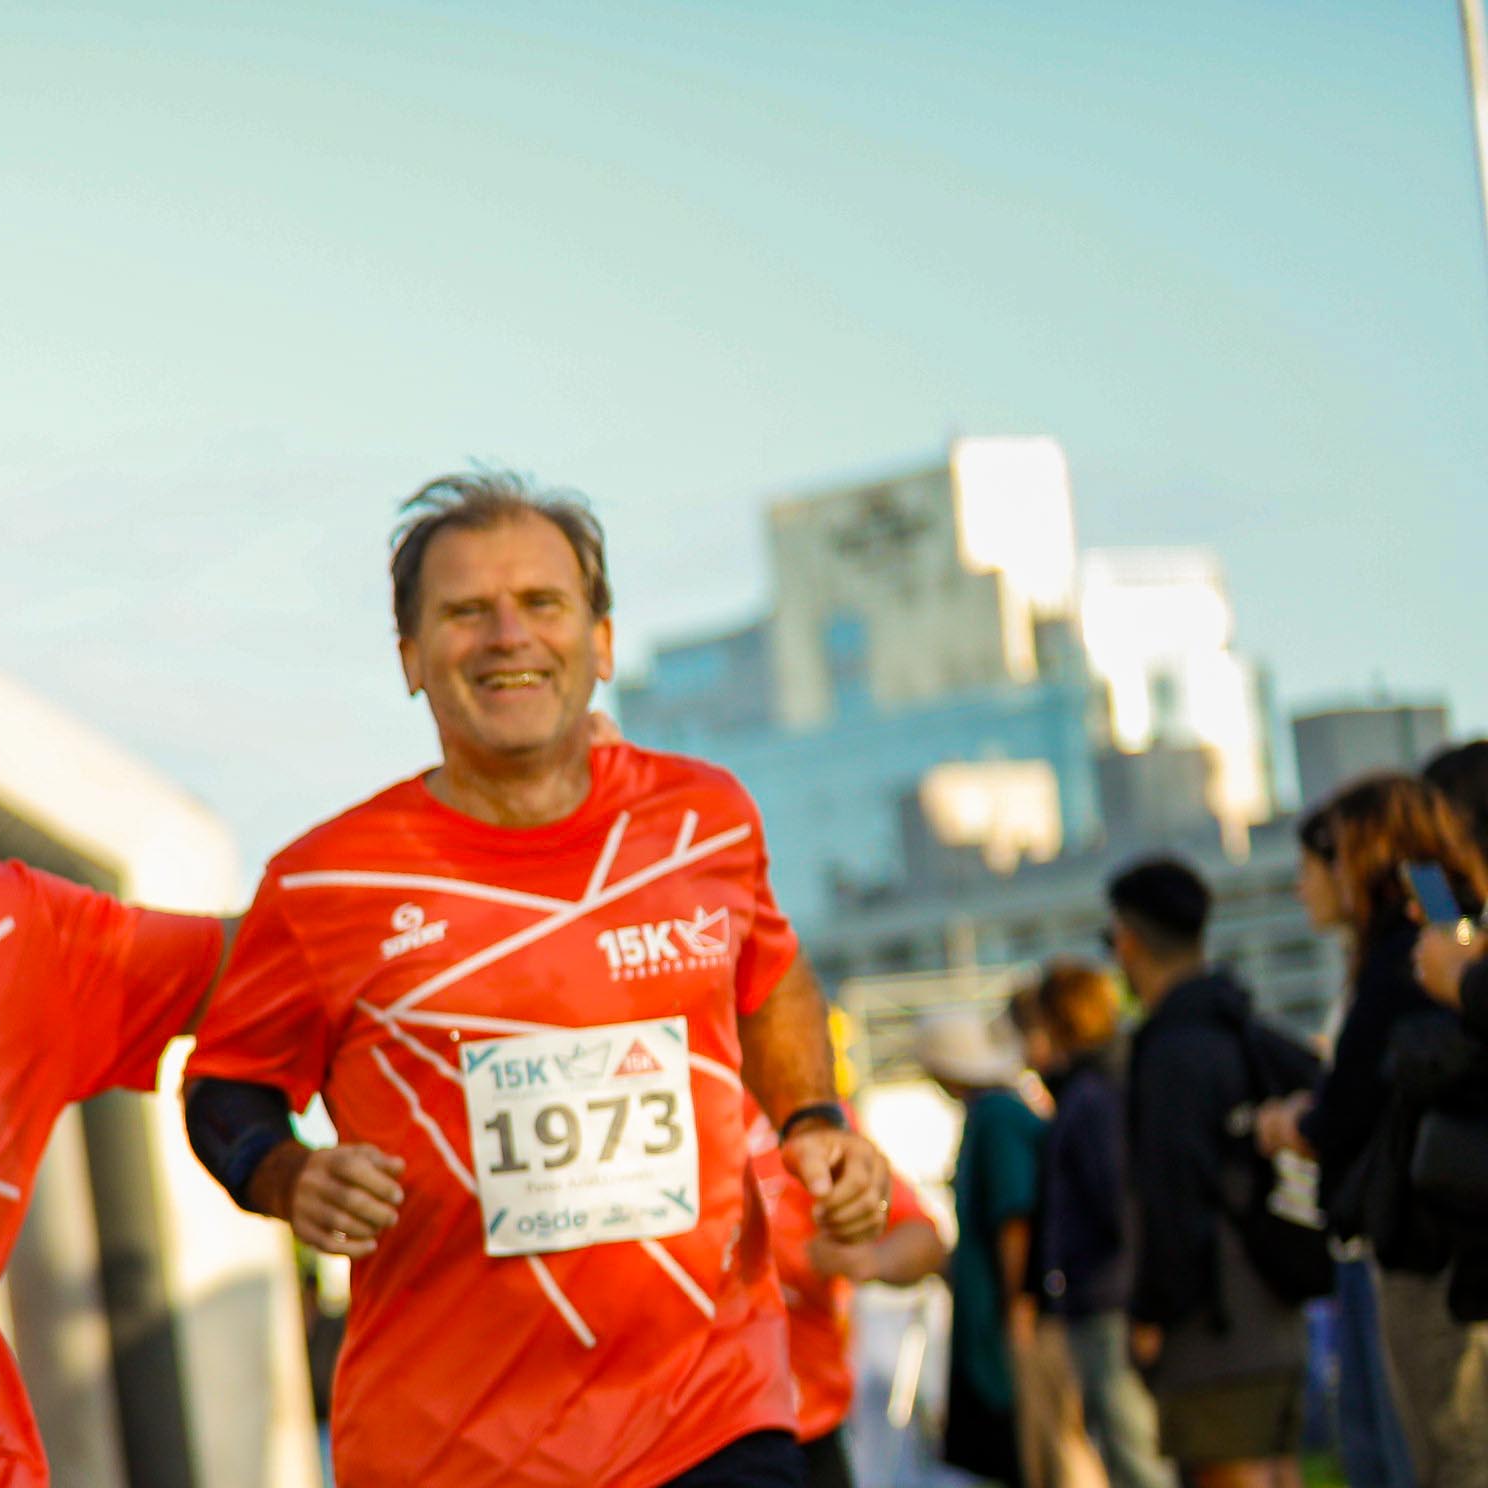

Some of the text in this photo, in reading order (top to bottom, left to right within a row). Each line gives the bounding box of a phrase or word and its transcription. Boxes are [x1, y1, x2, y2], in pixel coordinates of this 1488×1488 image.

[596, 921, 680, 969] 15K
[490, 1056, 548, 1090] 15K
[485, 1090, 684, 1175] 1973
